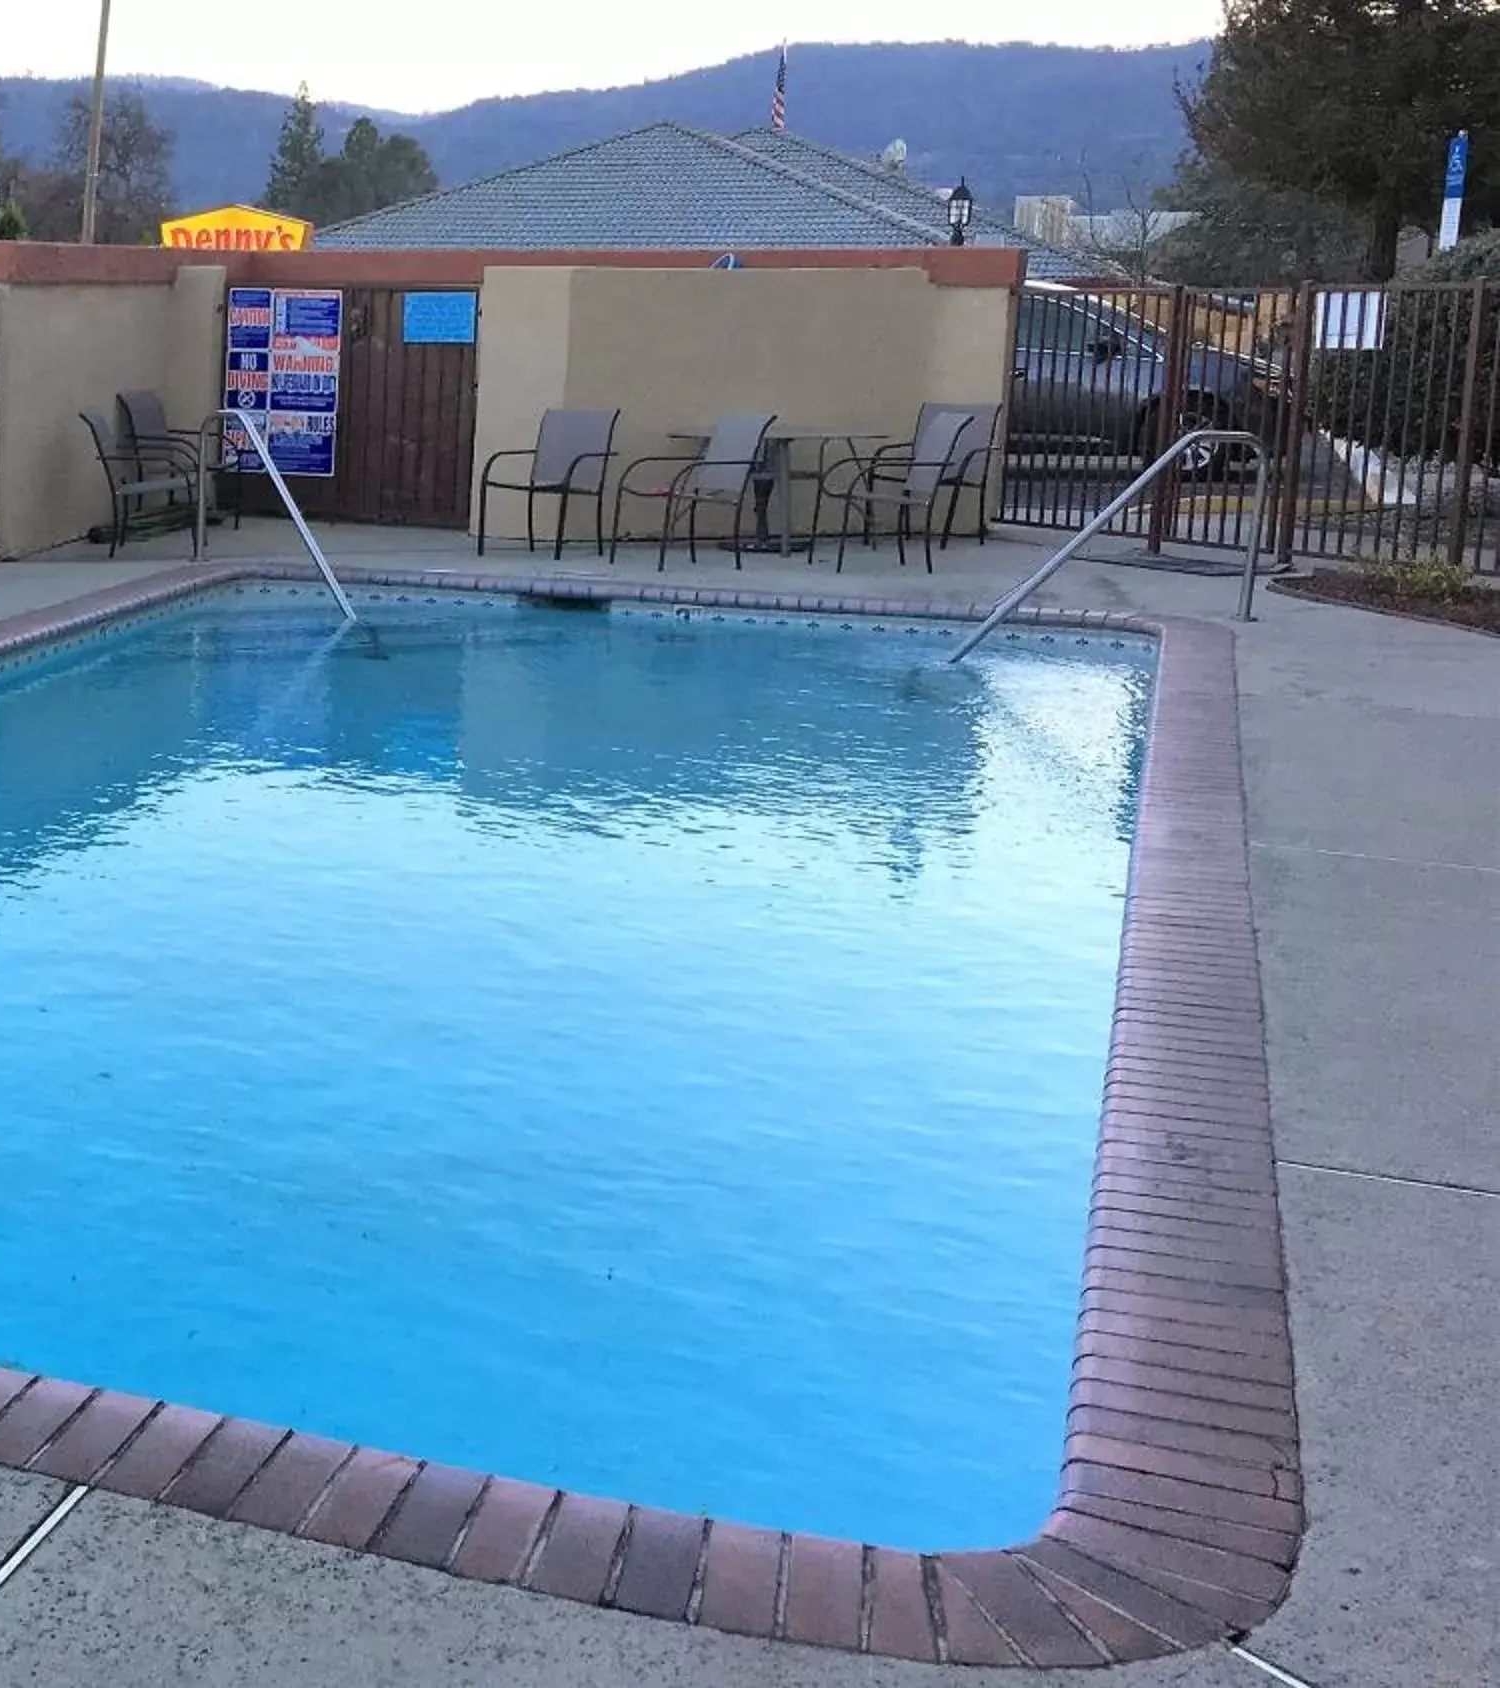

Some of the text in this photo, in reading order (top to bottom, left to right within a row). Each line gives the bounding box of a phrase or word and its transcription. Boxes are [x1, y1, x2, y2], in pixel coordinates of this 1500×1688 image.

[171, 225, 295, 250] Denny's
[241, 353, 257, 370] NO
[228, 372, 268, 389] DIVING
[308, 415, 335, 433] RULES
